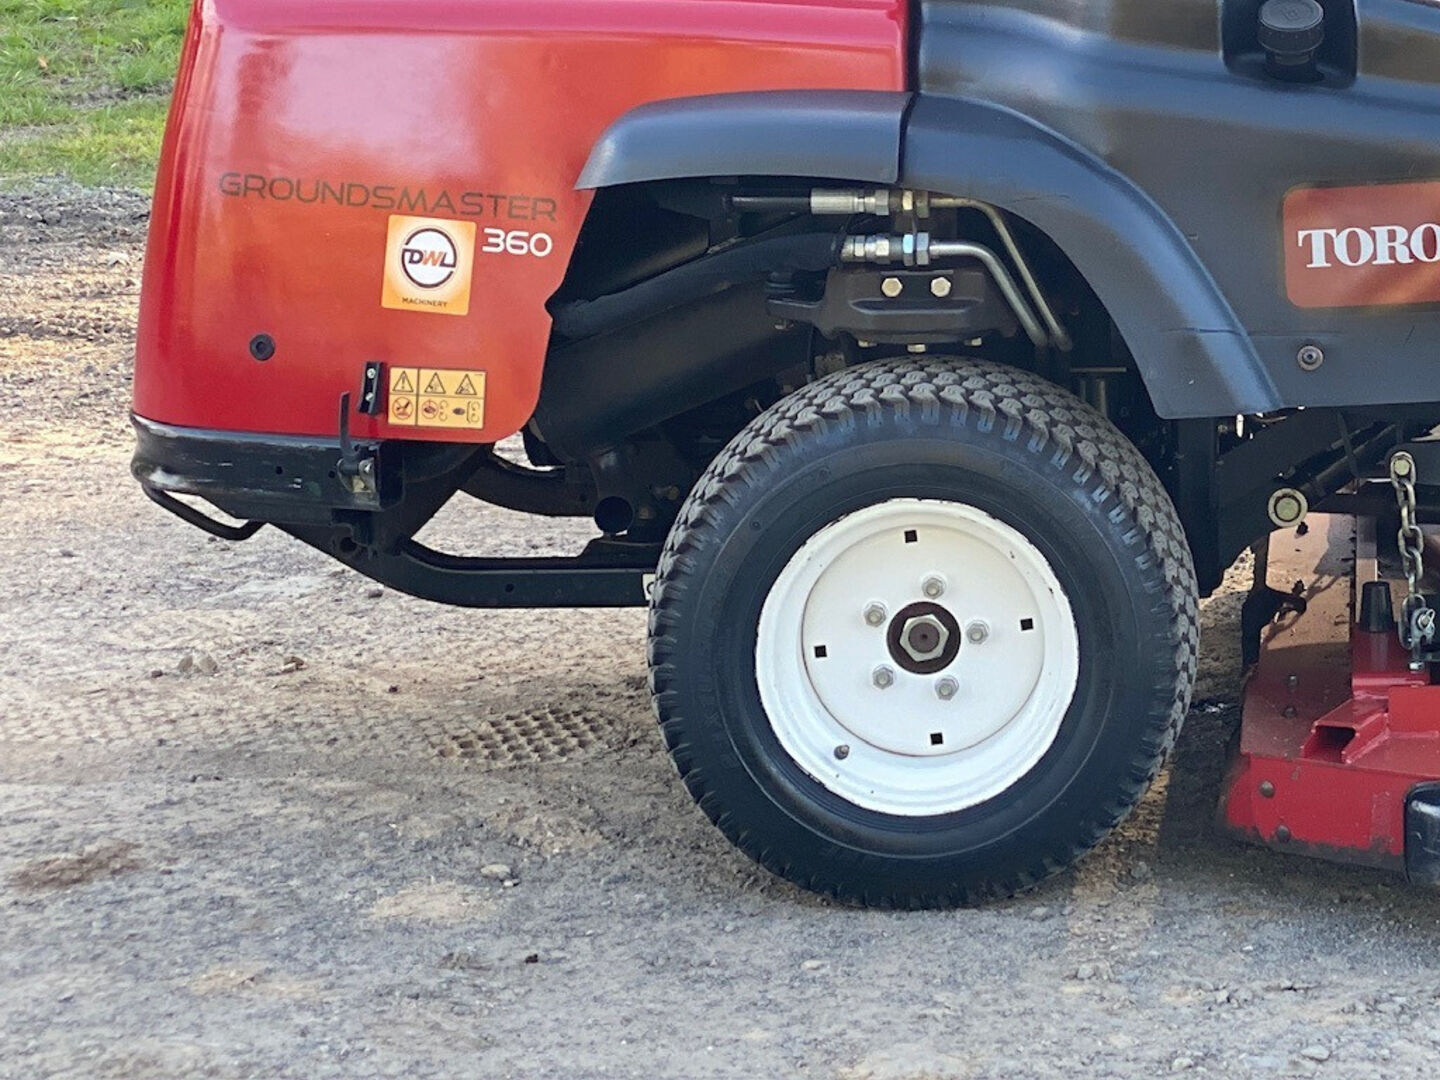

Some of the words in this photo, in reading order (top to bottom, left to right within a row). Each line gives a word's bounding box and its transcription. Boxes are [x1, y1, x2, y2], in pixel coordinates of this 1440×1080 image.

[219, 172, 558, 221] GROUNDSMASTER
[481, 227, 553, 257] 360
[402, 248, 457, 268] DWL
[401, 296, 448, 308] MACHINERY
